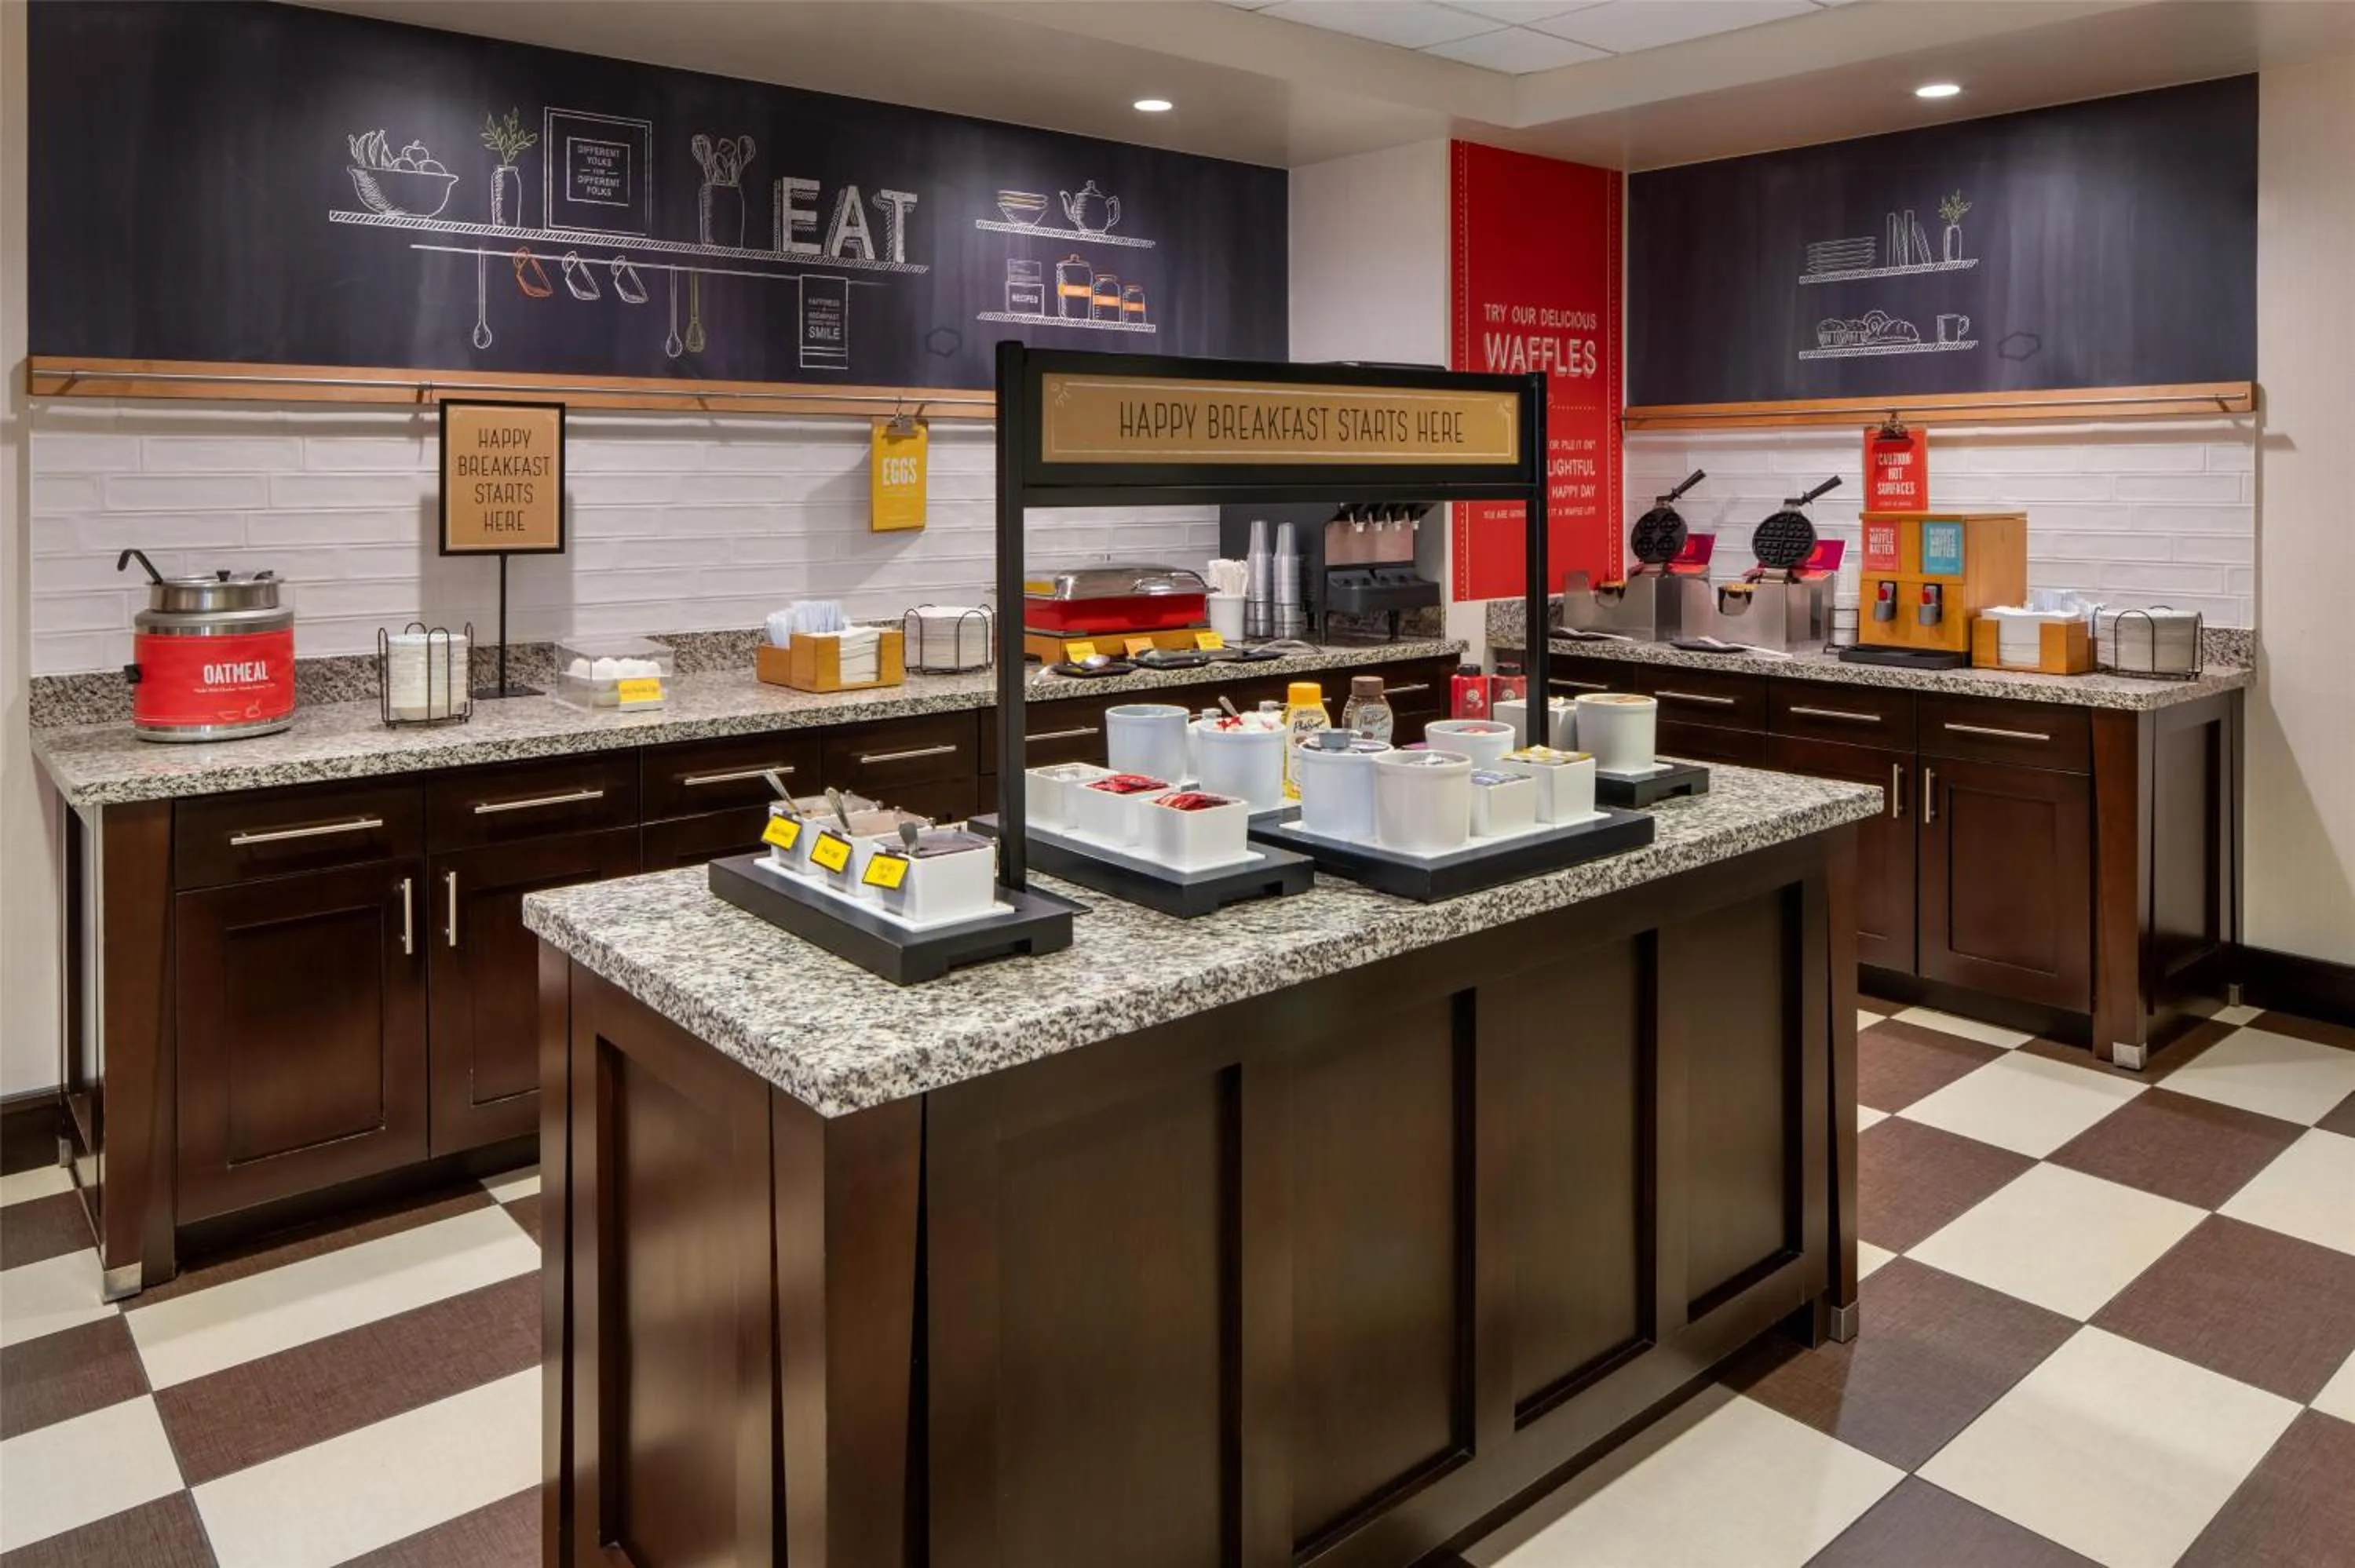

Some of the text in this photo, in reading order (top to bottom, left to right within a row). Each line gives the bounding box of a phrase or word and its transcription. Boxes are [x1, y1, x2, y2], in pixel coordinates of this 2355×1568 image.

[577, 144, 619, 157] DIFFERENT
[586, 156, 612, 167] YOLKS
[577, 175, 619, 188] DIFFERENT
[586, 185, 612, 197] FOLKS
[774, 177, 918, 263] EAT
[1484, 303, 1597, 330] TRY OUR DELICIOUS
[808, 326, 841, 340] SMILE
[1484, 331, 1597, 378] WAFFLES
[1120, 401, 1464, 443] HAPPY BREAKFAST STARTS HERE
[478, 428, 532, 449] HAPPY
[458, 454, 550, 477] BREAKFAST
[882, 458, 917, 485] EGGS
[1547, 458, 1596, 476] LIGHTFUL
[1888, 467, 1903, 480] HOT
[475, 483, 534, 505] STARTS
[1552, 484, 1596, 498] HAPPY DAY
[1877, 481, 1915, 495] SURFACES
[484, 510, 526, 532] HERE
[204, 660, 269, 685] OATMEAL
